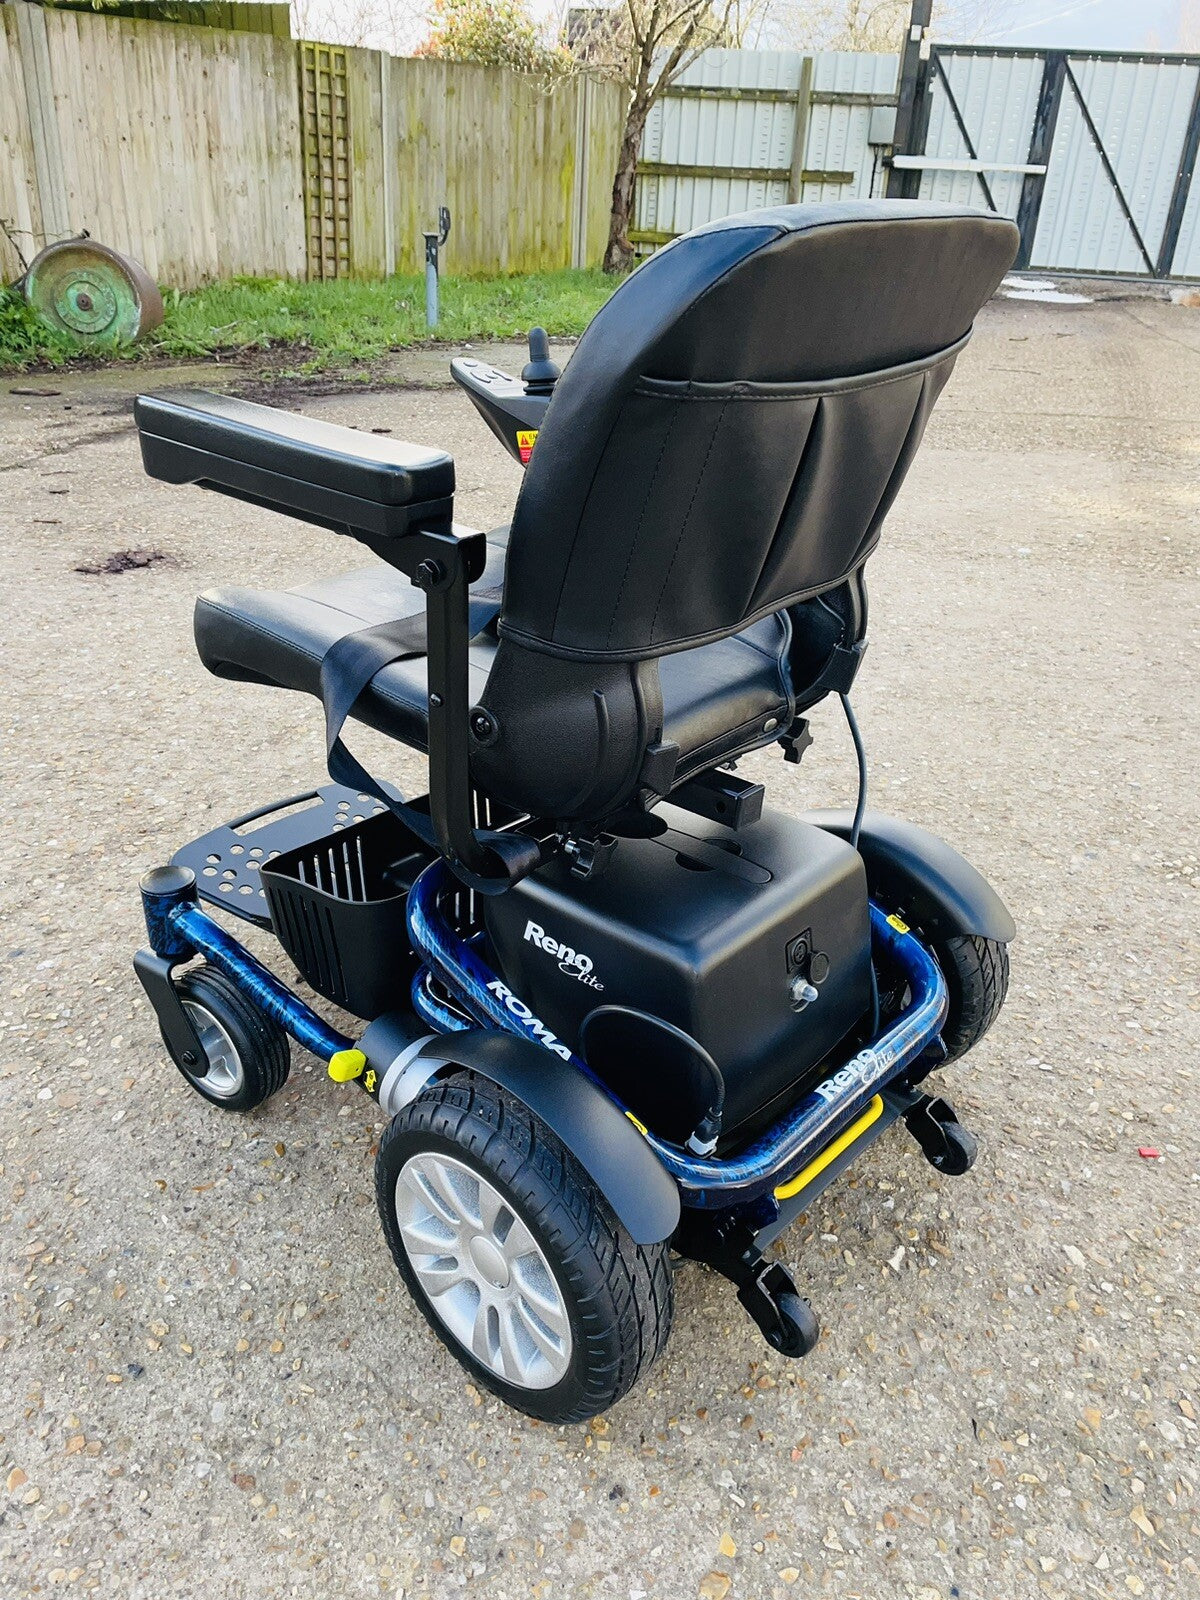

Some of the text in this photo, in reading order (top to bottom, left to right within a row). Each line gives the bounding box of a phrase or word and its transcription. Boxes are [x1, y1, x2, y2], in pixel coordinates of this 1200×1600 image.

[523, 920, 594, 976] Reno
[486, 979, 573, 1061] ROMA
[813, 1048, 877, 1102] Reno
